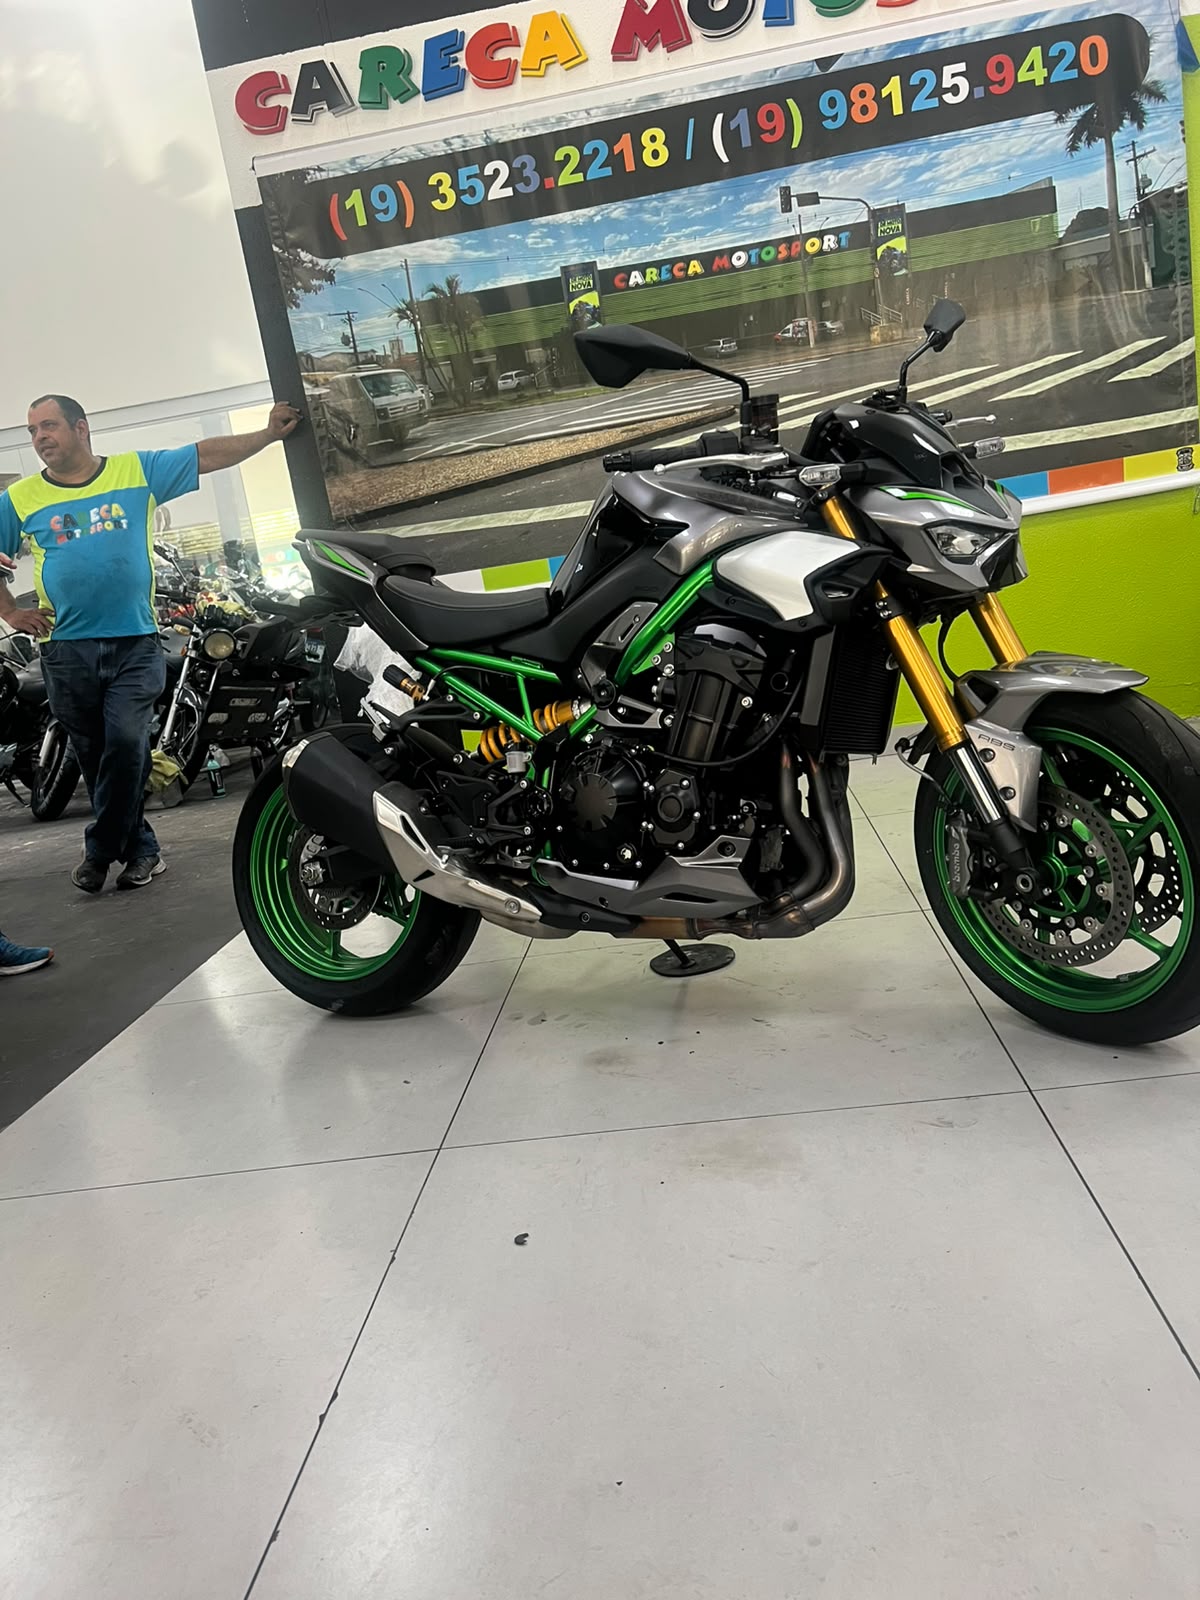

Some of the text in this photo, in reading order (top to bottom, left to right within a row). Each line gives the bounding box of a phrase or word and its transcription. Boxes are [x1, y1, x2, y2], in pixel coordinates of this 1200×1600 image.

[235, 10, 588, 136] CARECA
[329, 179, 415, 241] (19)
[428, 127, 669, 211] 3523.2218
[711, 98, 803, 163] (19)
[819, 35, 1109, 131] 98125.9420
[879, 224, 901, 236] NOVA
[614, 231, 850, 290] CARECA MOTOSPORT
[571, 280, 593, 291] NOVA
[978, 733, 1016, 751] ABS
[951, 842, 961, 883] brembo
